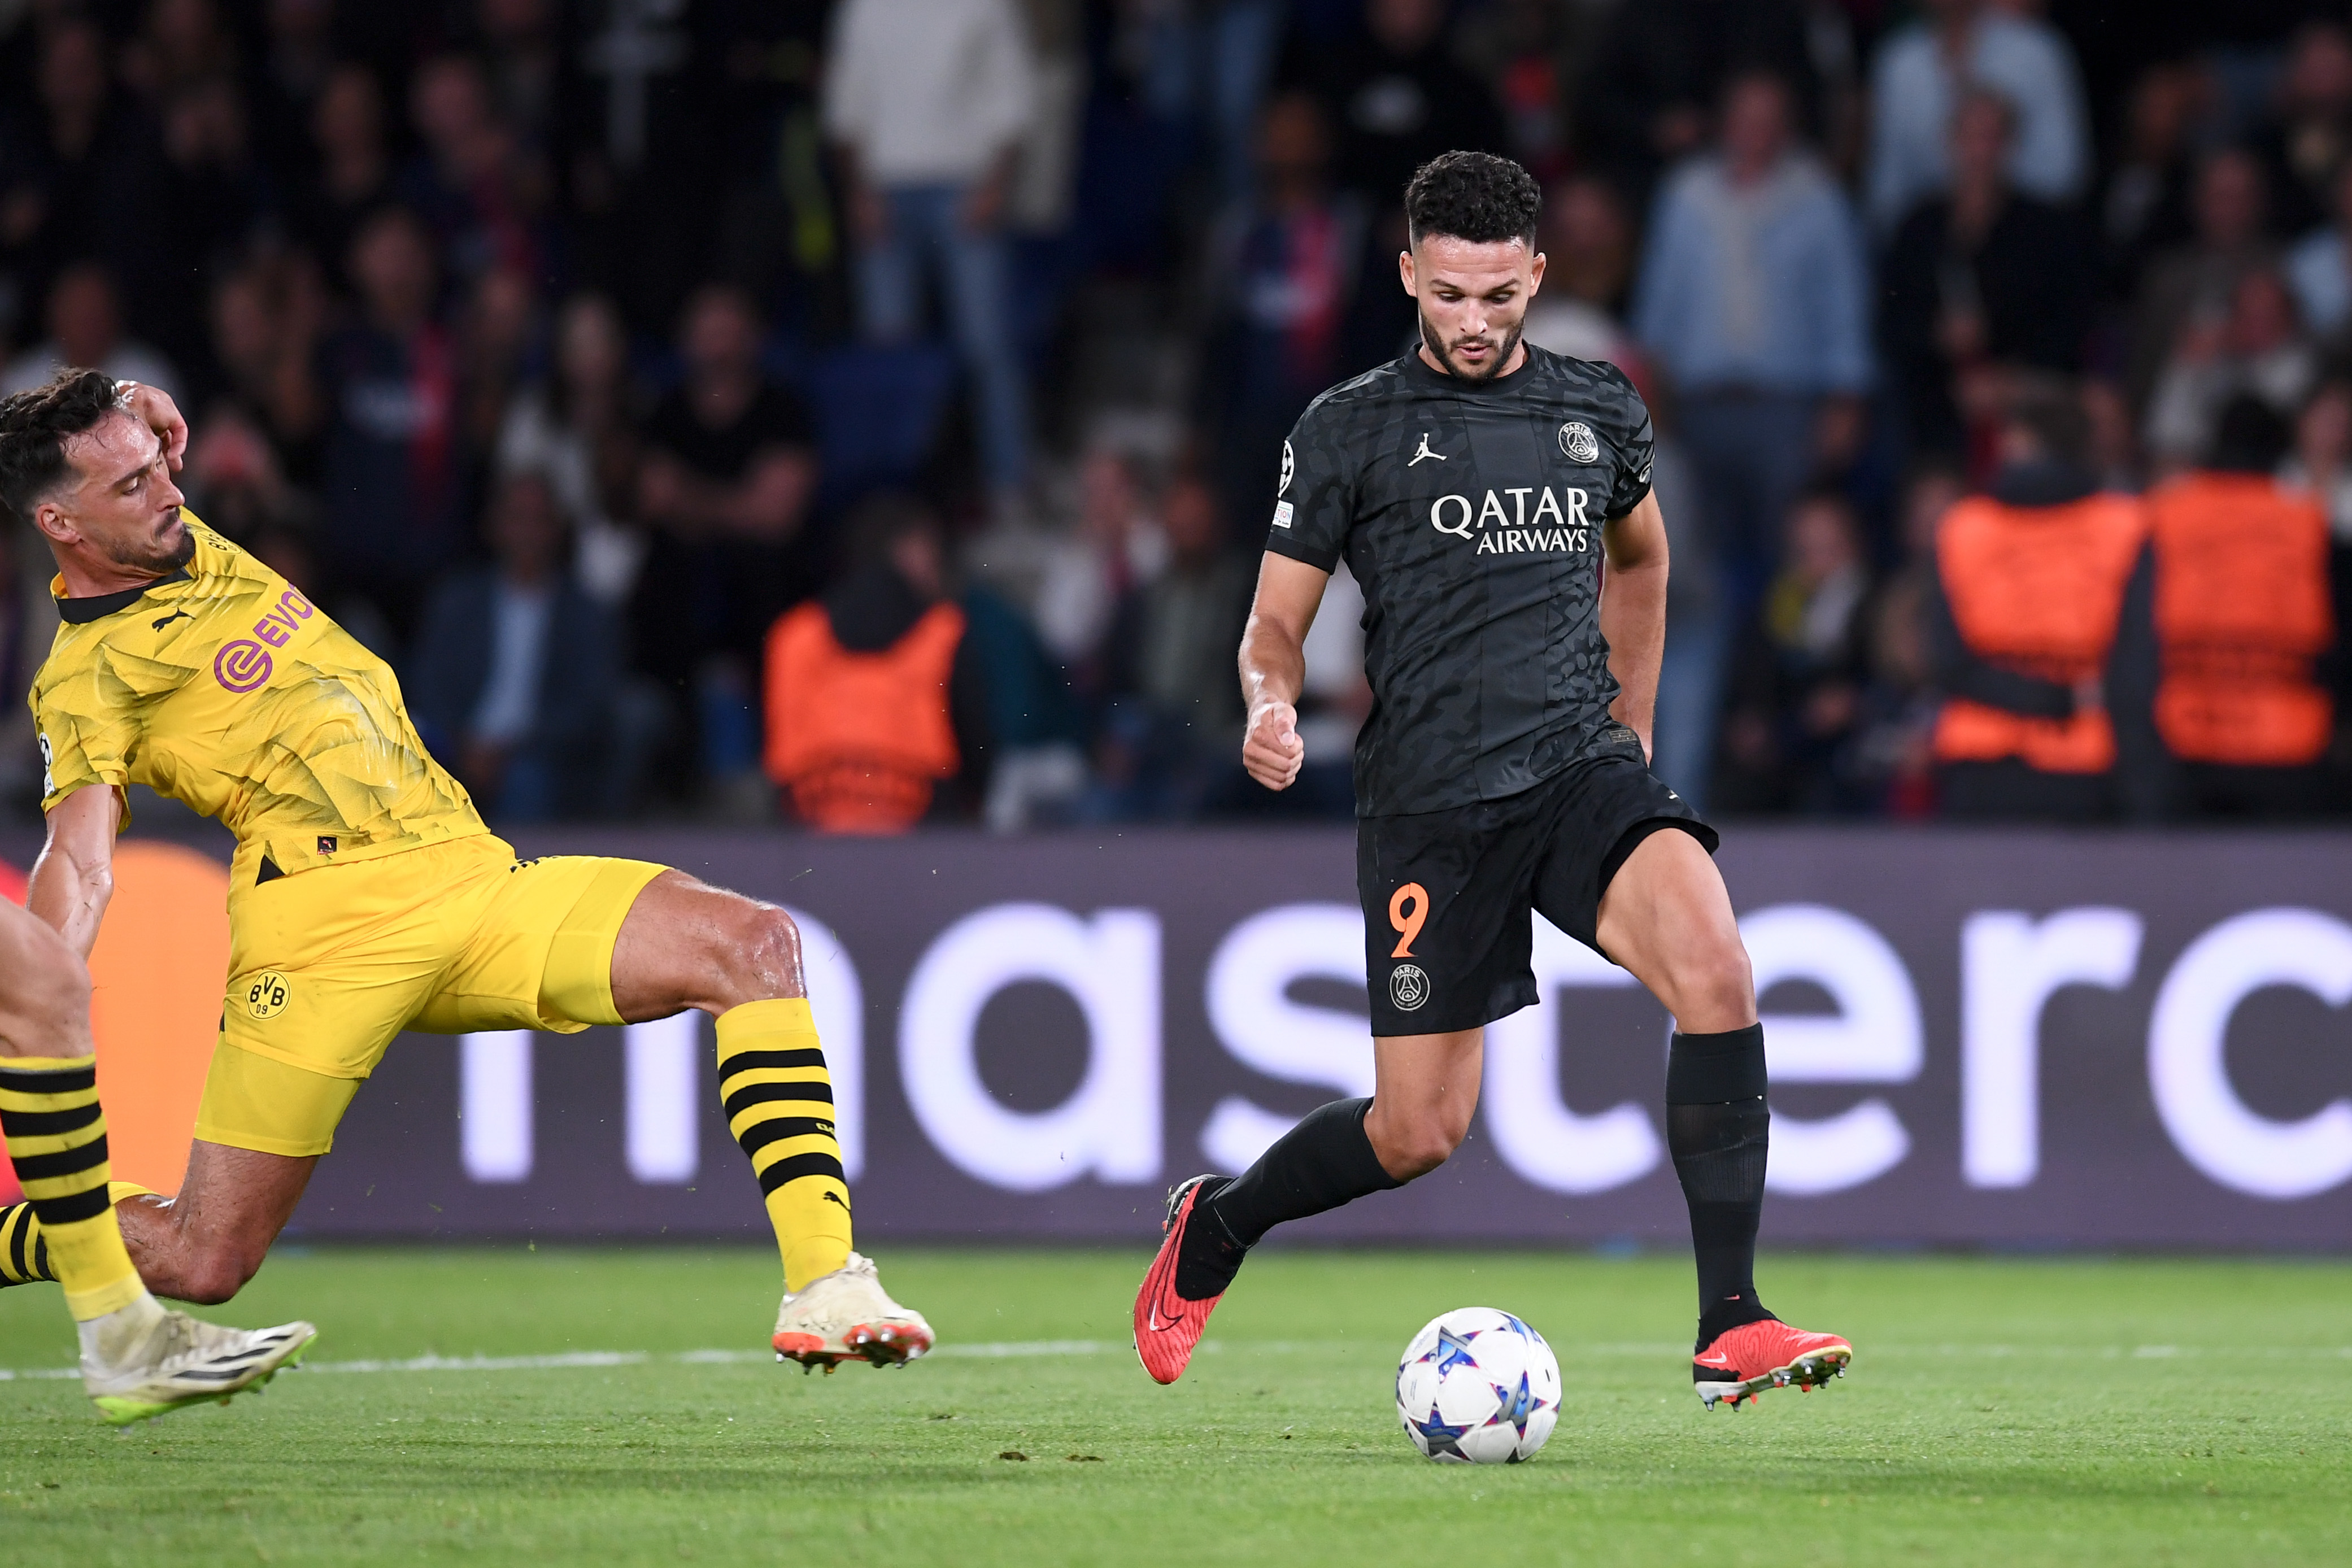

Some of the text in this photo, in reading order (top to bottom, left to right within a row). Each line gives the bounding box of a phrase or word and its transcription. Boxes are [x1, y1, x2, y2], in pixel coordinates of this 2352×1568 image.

[1563, 424, 1589, 436] PARIS
[1275, 508, 1291, 520] TION
[1431, 486, 1589, 540] QATAR
[1476, 529, 1587, 555] AIRWAYS
[252, 582, 315, 648] EVO
[1389, 882, 1429, 958] 9
[1394, 966, 1421, 979] PARIS
[250, 976, 285, 1007] BVB
[256, 1004, 268, 1014] 09
